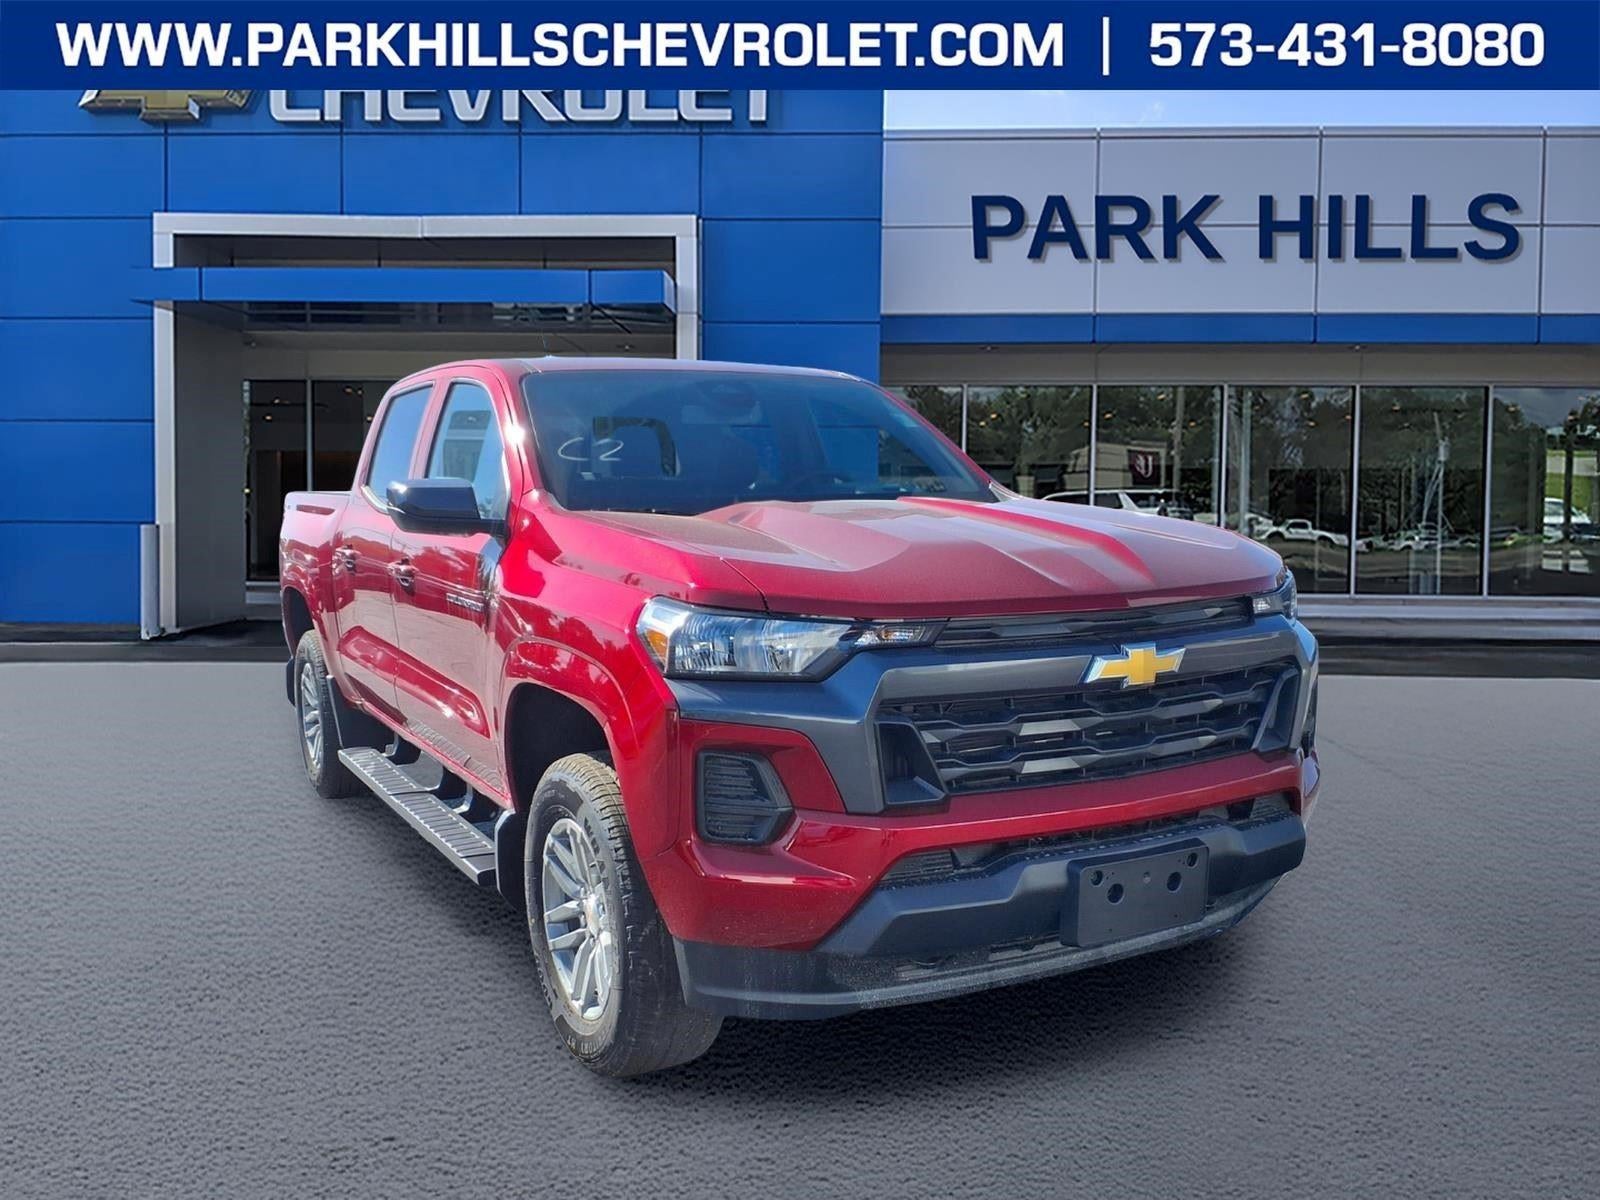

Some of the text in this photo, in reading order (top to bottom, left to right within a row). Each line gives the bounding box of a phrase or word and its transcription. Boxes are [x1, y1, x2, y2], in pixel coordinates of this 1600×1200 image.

[971, 193, 1521, 260] PARK HILLS
[557, 436, 624, 461] C2
